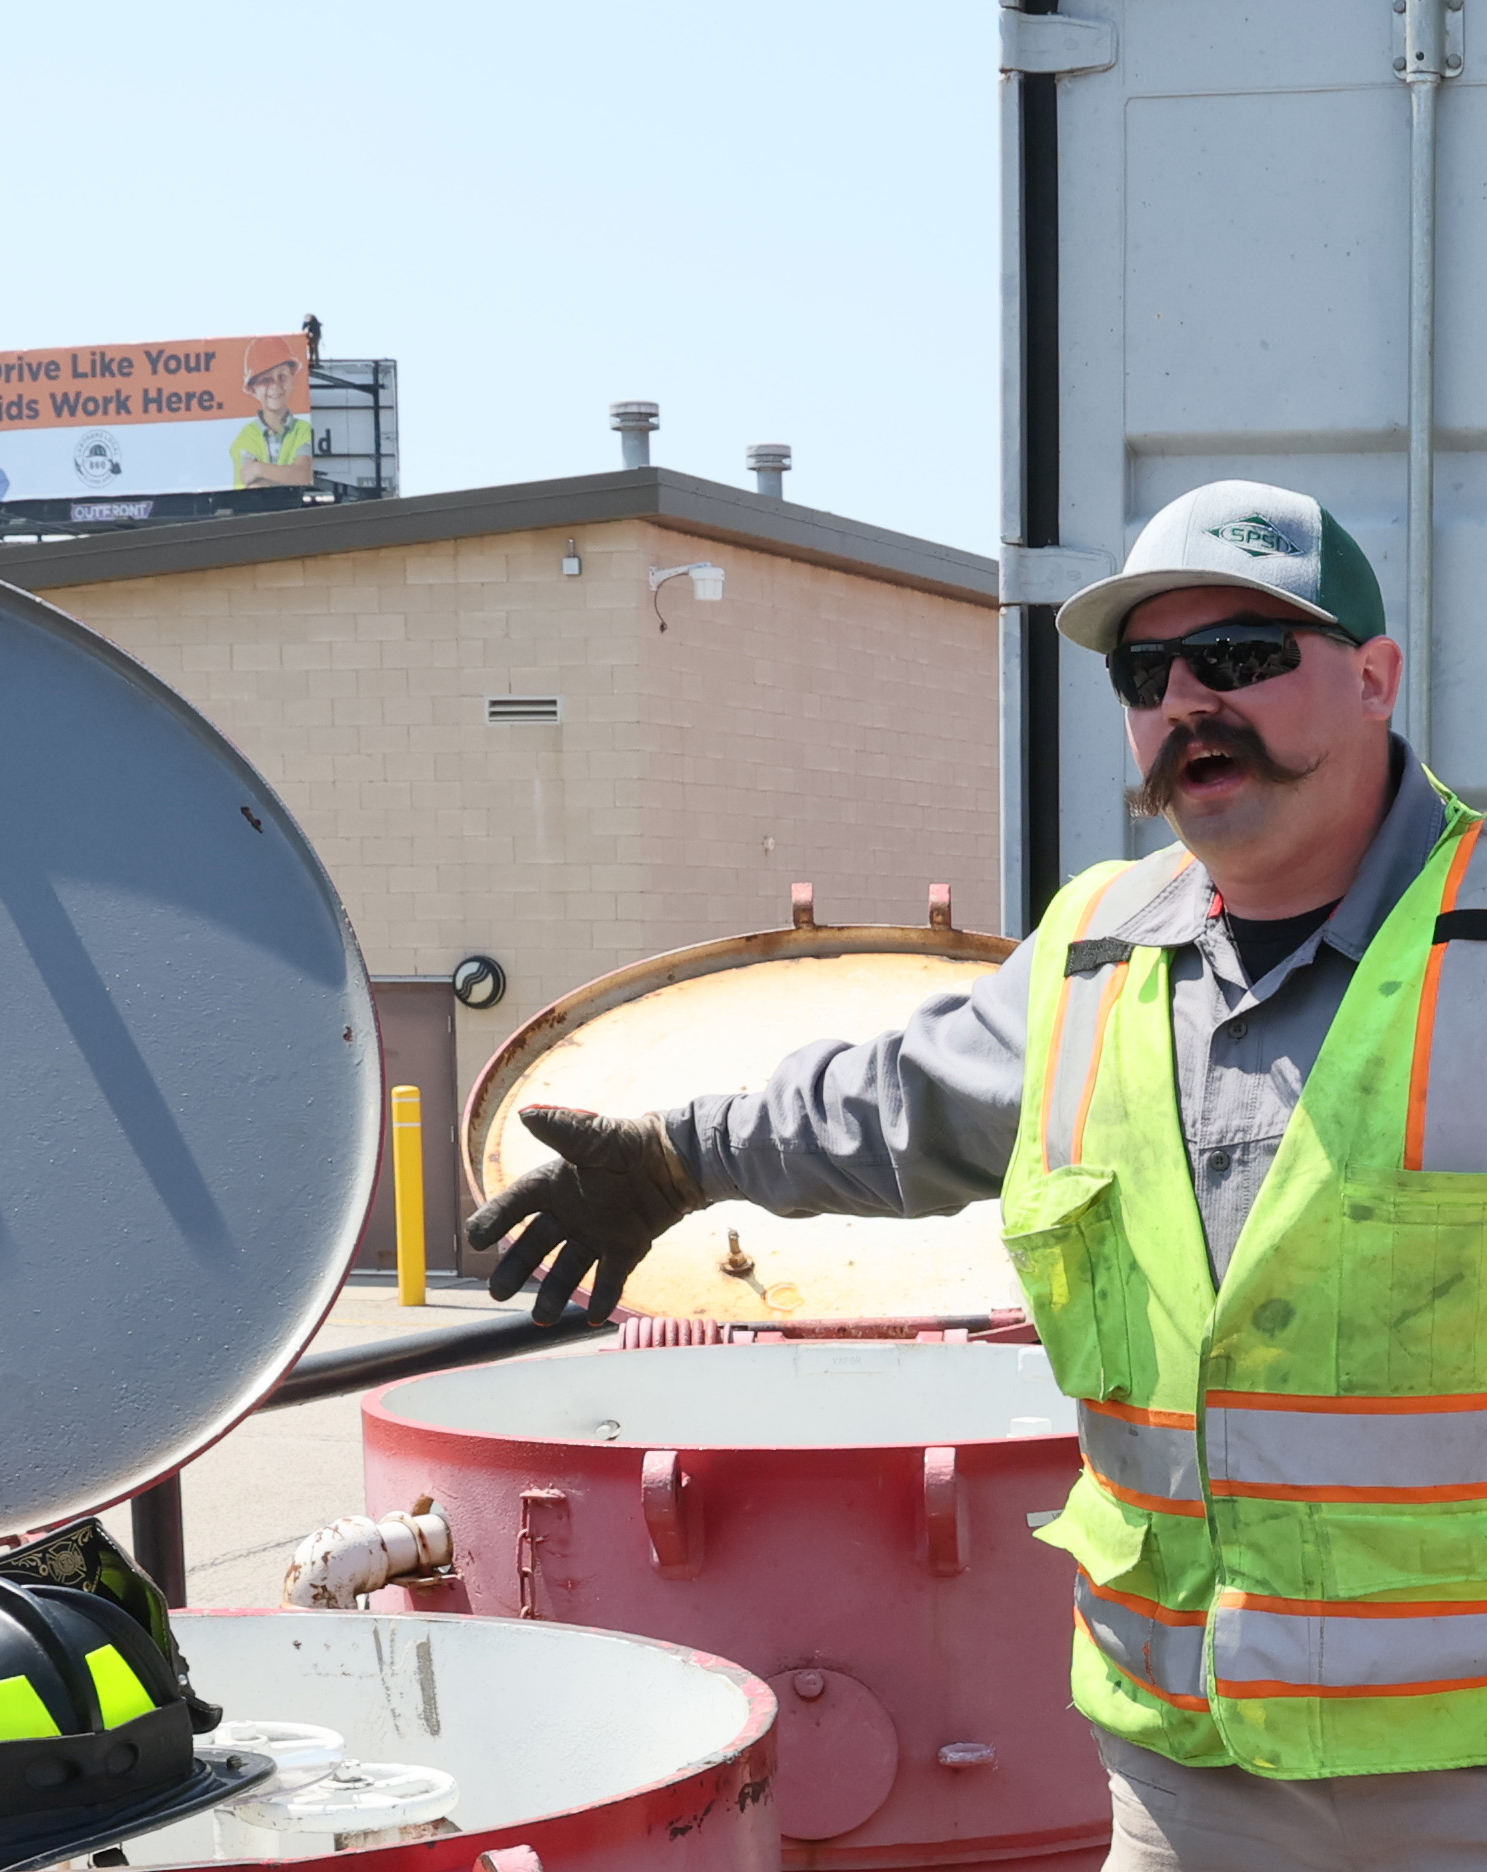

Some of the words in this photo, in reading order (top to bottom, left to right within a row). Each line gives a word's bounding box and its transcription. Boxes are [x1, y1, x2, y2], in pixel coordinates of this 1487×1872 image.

[71, 351, 134, 379] Like
[143, 349, 216, 376] Your
[49, 389, 133, 418] Work
[142, 387, 224, 414] Here.
[75, 503, 147, 518] OUTFRONT
[1230, 527, 1280, 551] SPSI
